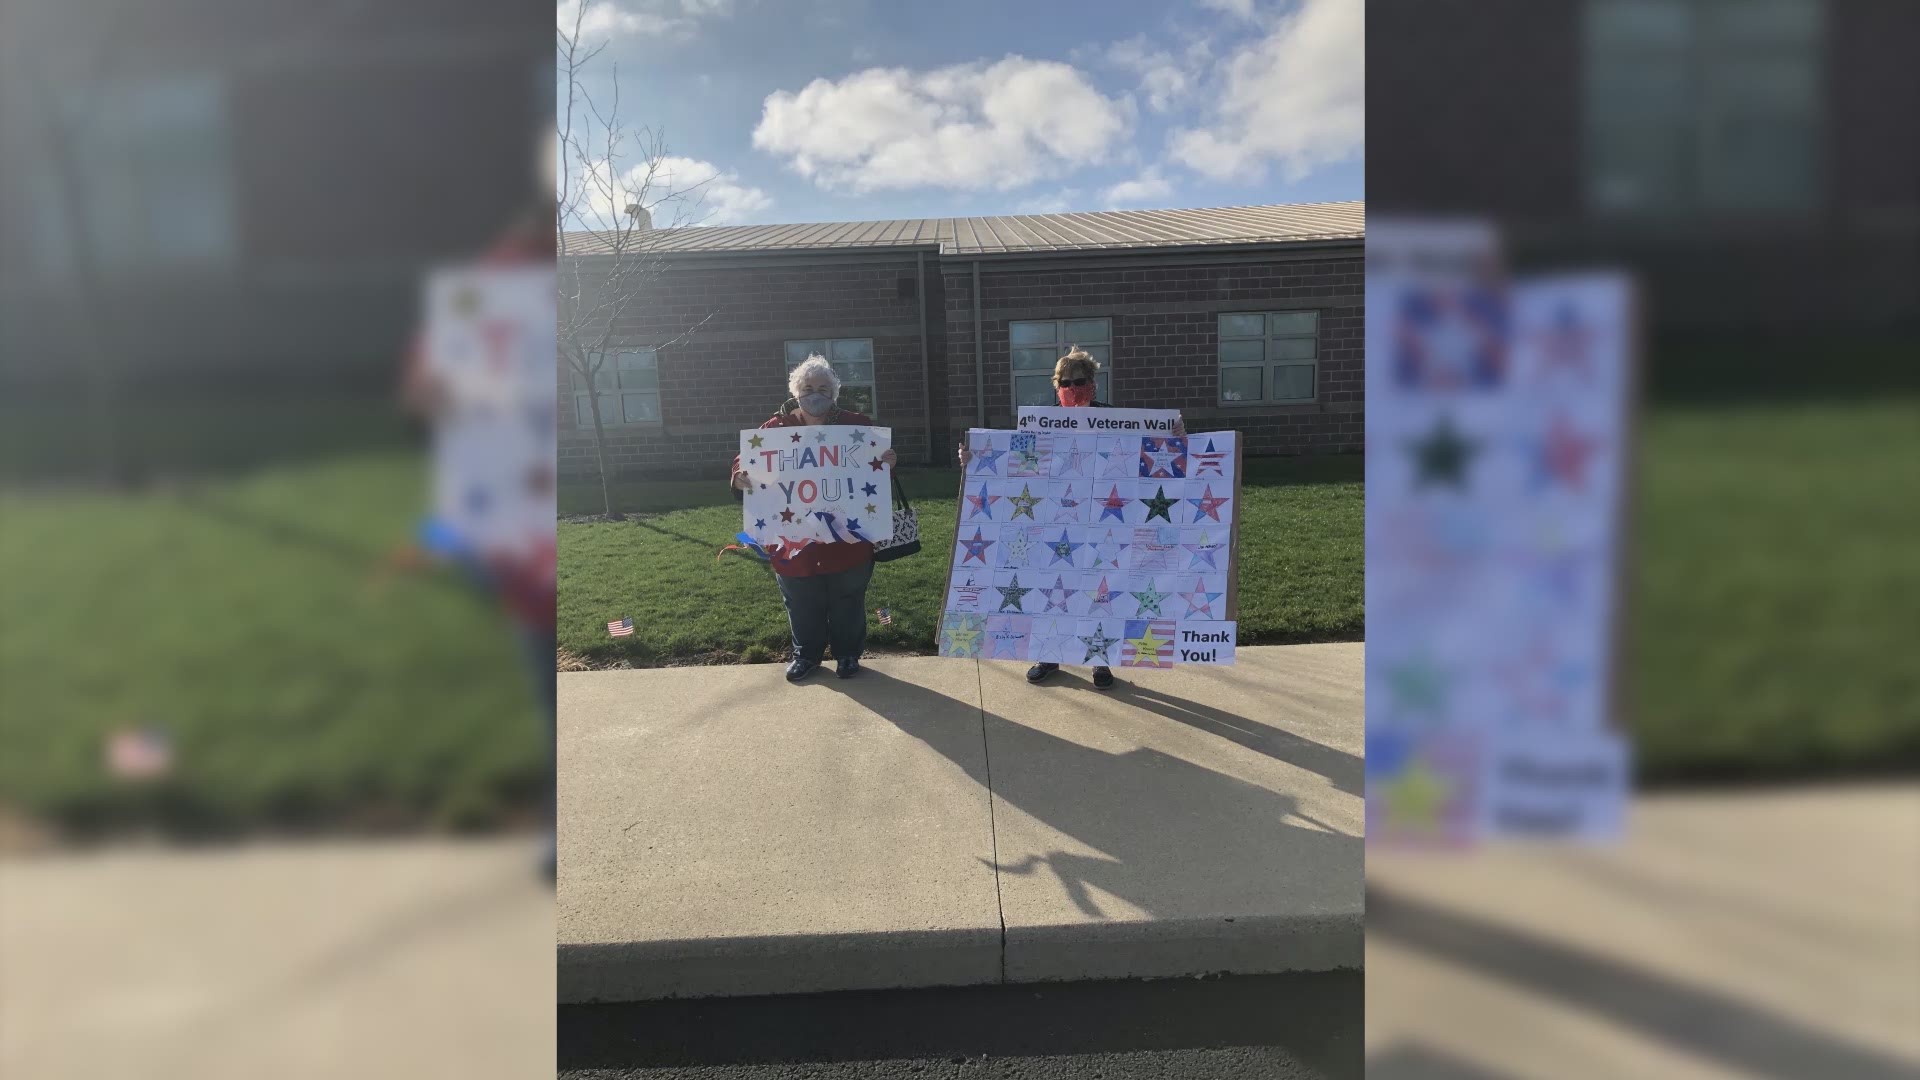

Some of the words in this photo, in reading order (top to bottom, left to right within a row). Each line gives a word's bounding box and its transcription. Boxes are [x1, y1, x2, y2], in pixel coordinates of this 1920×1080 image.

[1019, 414, 1037, 428] 4th
[1039, 416, 1078, 429] Grade
[1087, 417, 1140, 430] Veteran
[1144, 418, 1175, 431] Wall
[760, 445, 860, 473] THANK
[778, 478, 854, 504] YOU!
[1182, 630, 1230, 644] Thank
[1180, 649, 1216, 662] You!
